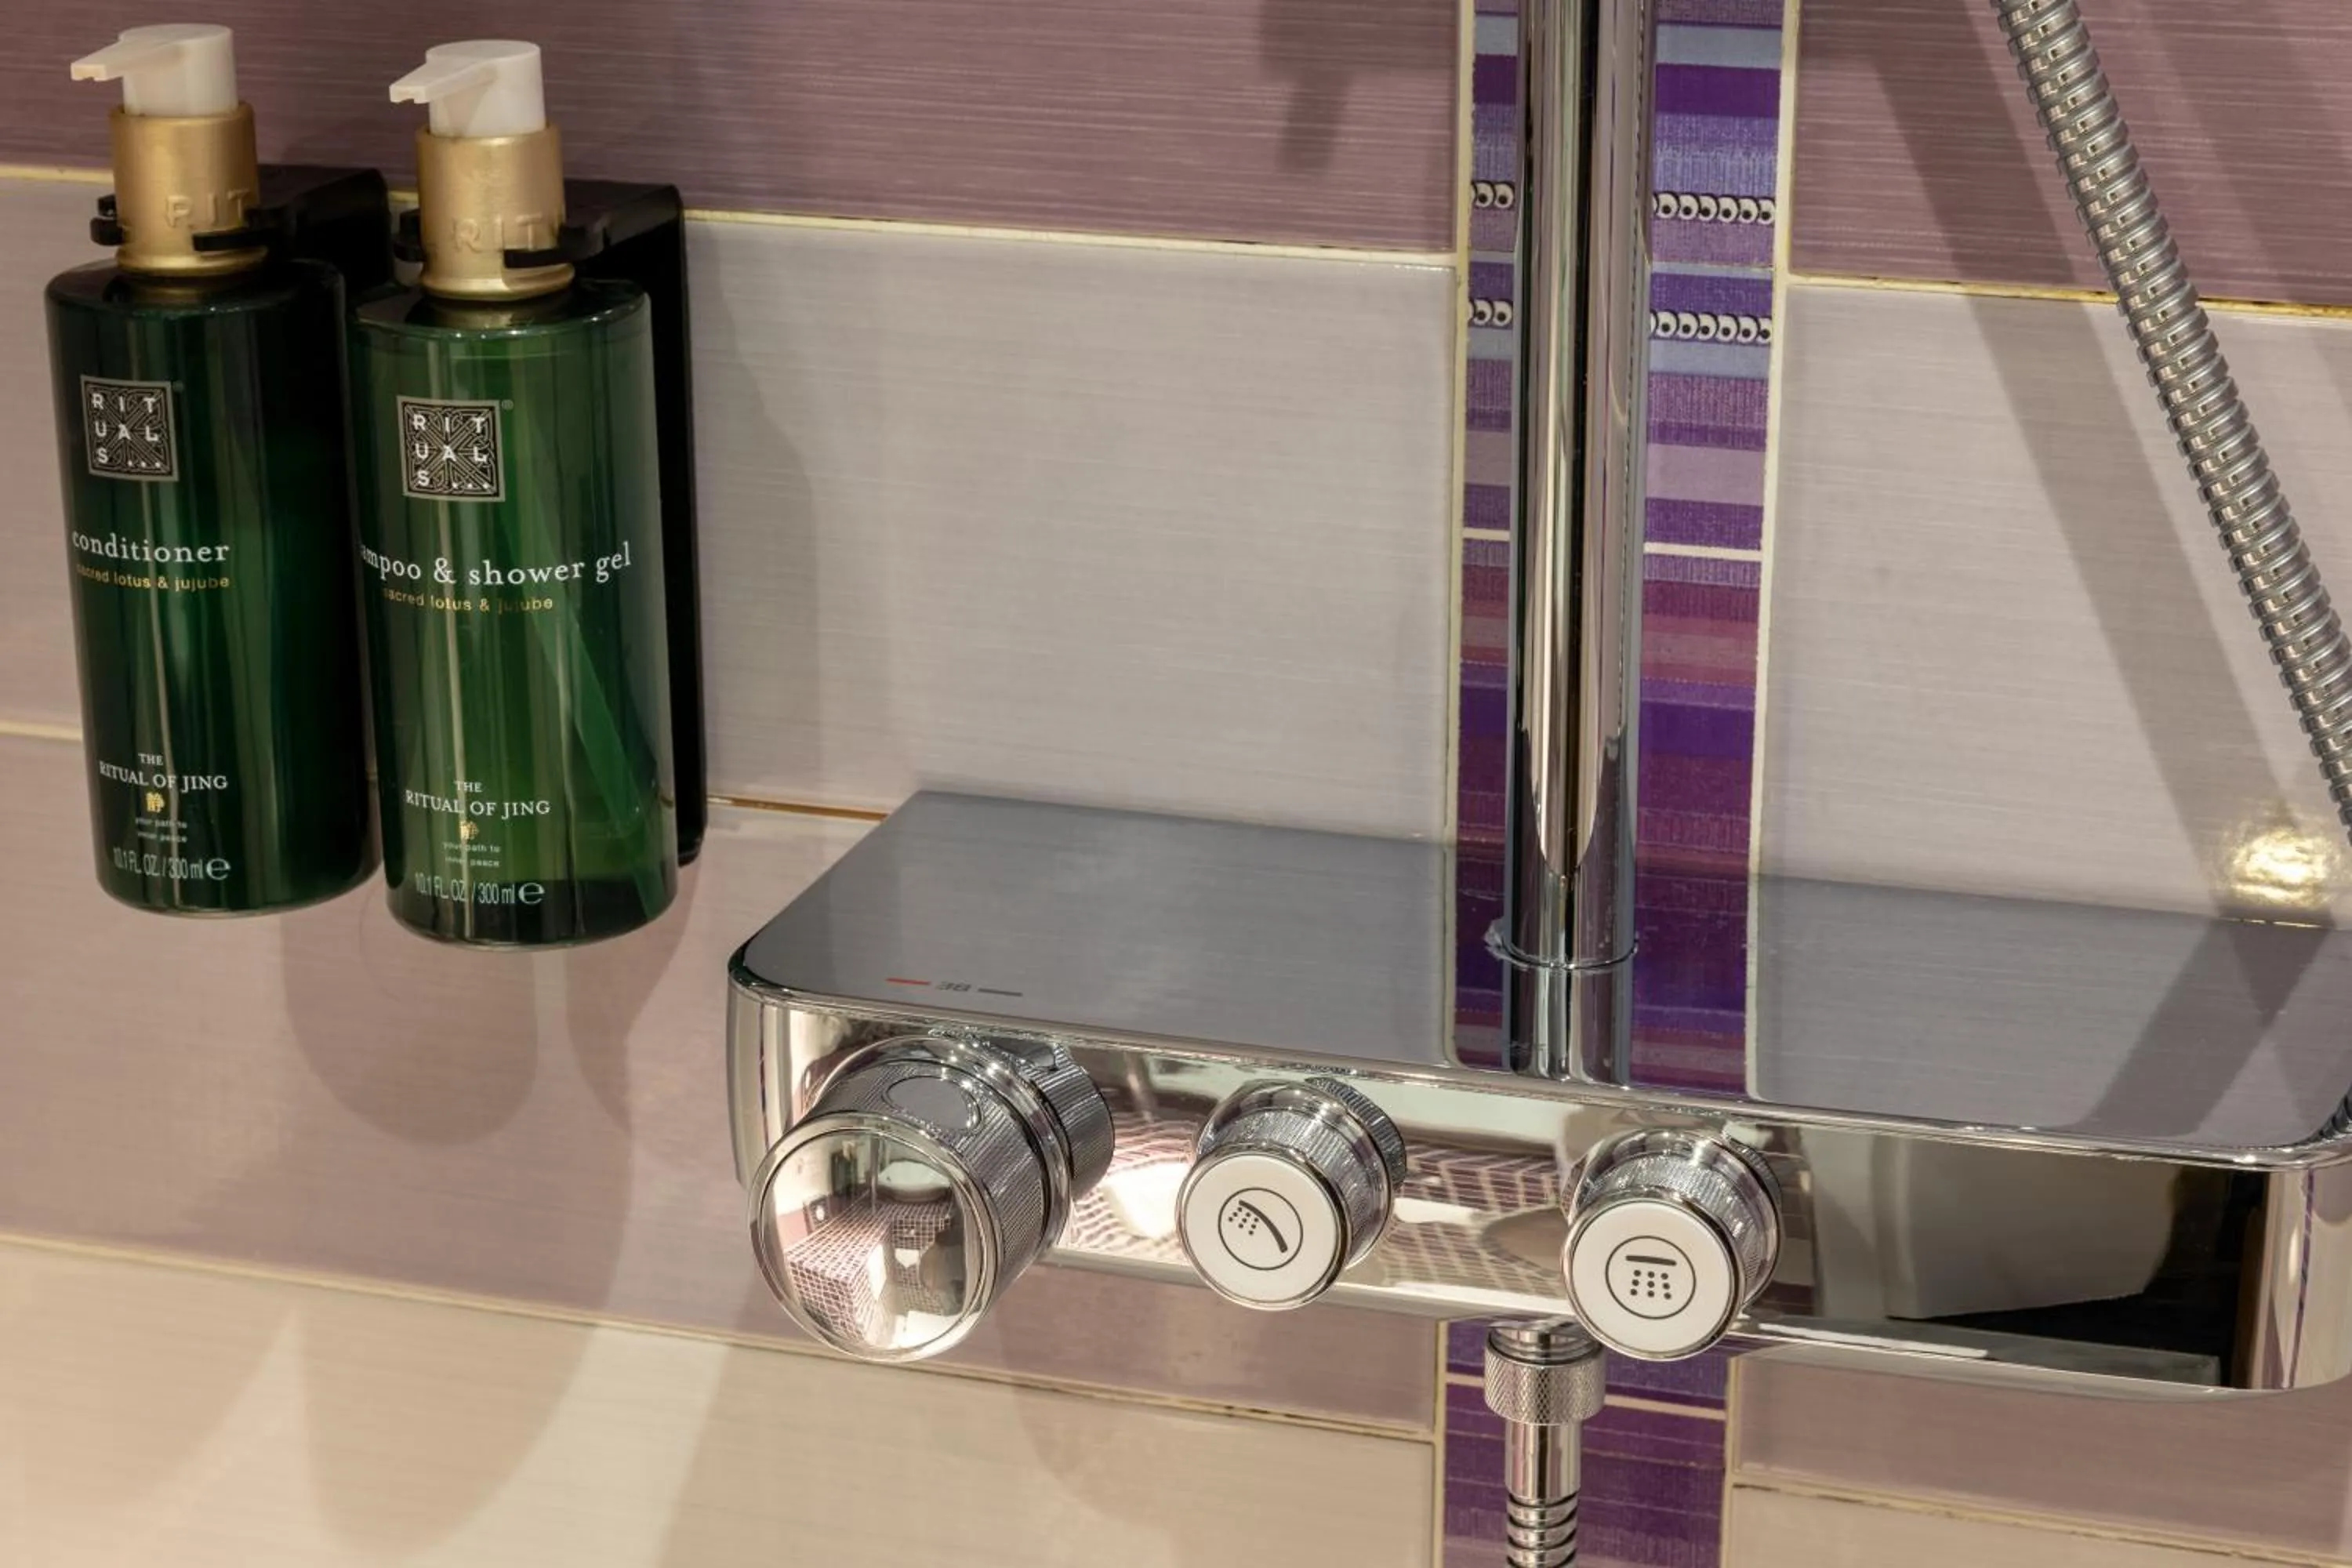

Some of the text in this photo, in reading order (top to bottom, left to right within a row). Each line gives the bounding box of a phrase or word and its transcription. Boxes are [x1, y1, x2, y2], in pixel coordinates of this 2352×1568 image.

[71, 531, 230, 563] conditioner
[434, 557, 456, 584] &
[469, 559, 586, 586] shower
[596, 541, 631, 583] gel
[114, 571, 151, 588] lotus
[157, 576, 169, 589] &
[174, 576, 230, 592] jujube
[430, 595, 472, 612] lotus
[479, 598, 490, 612] &
[138, 753, 163, 766] THE
[100, 760, 228, 793] RITUAL OF JING
[454, 780, 483, 793] THE
[405, 790, 550, 819] RITUAL OF JING
[129, 850, 142, 874] FL
[434, 876, 449, 899] FL
